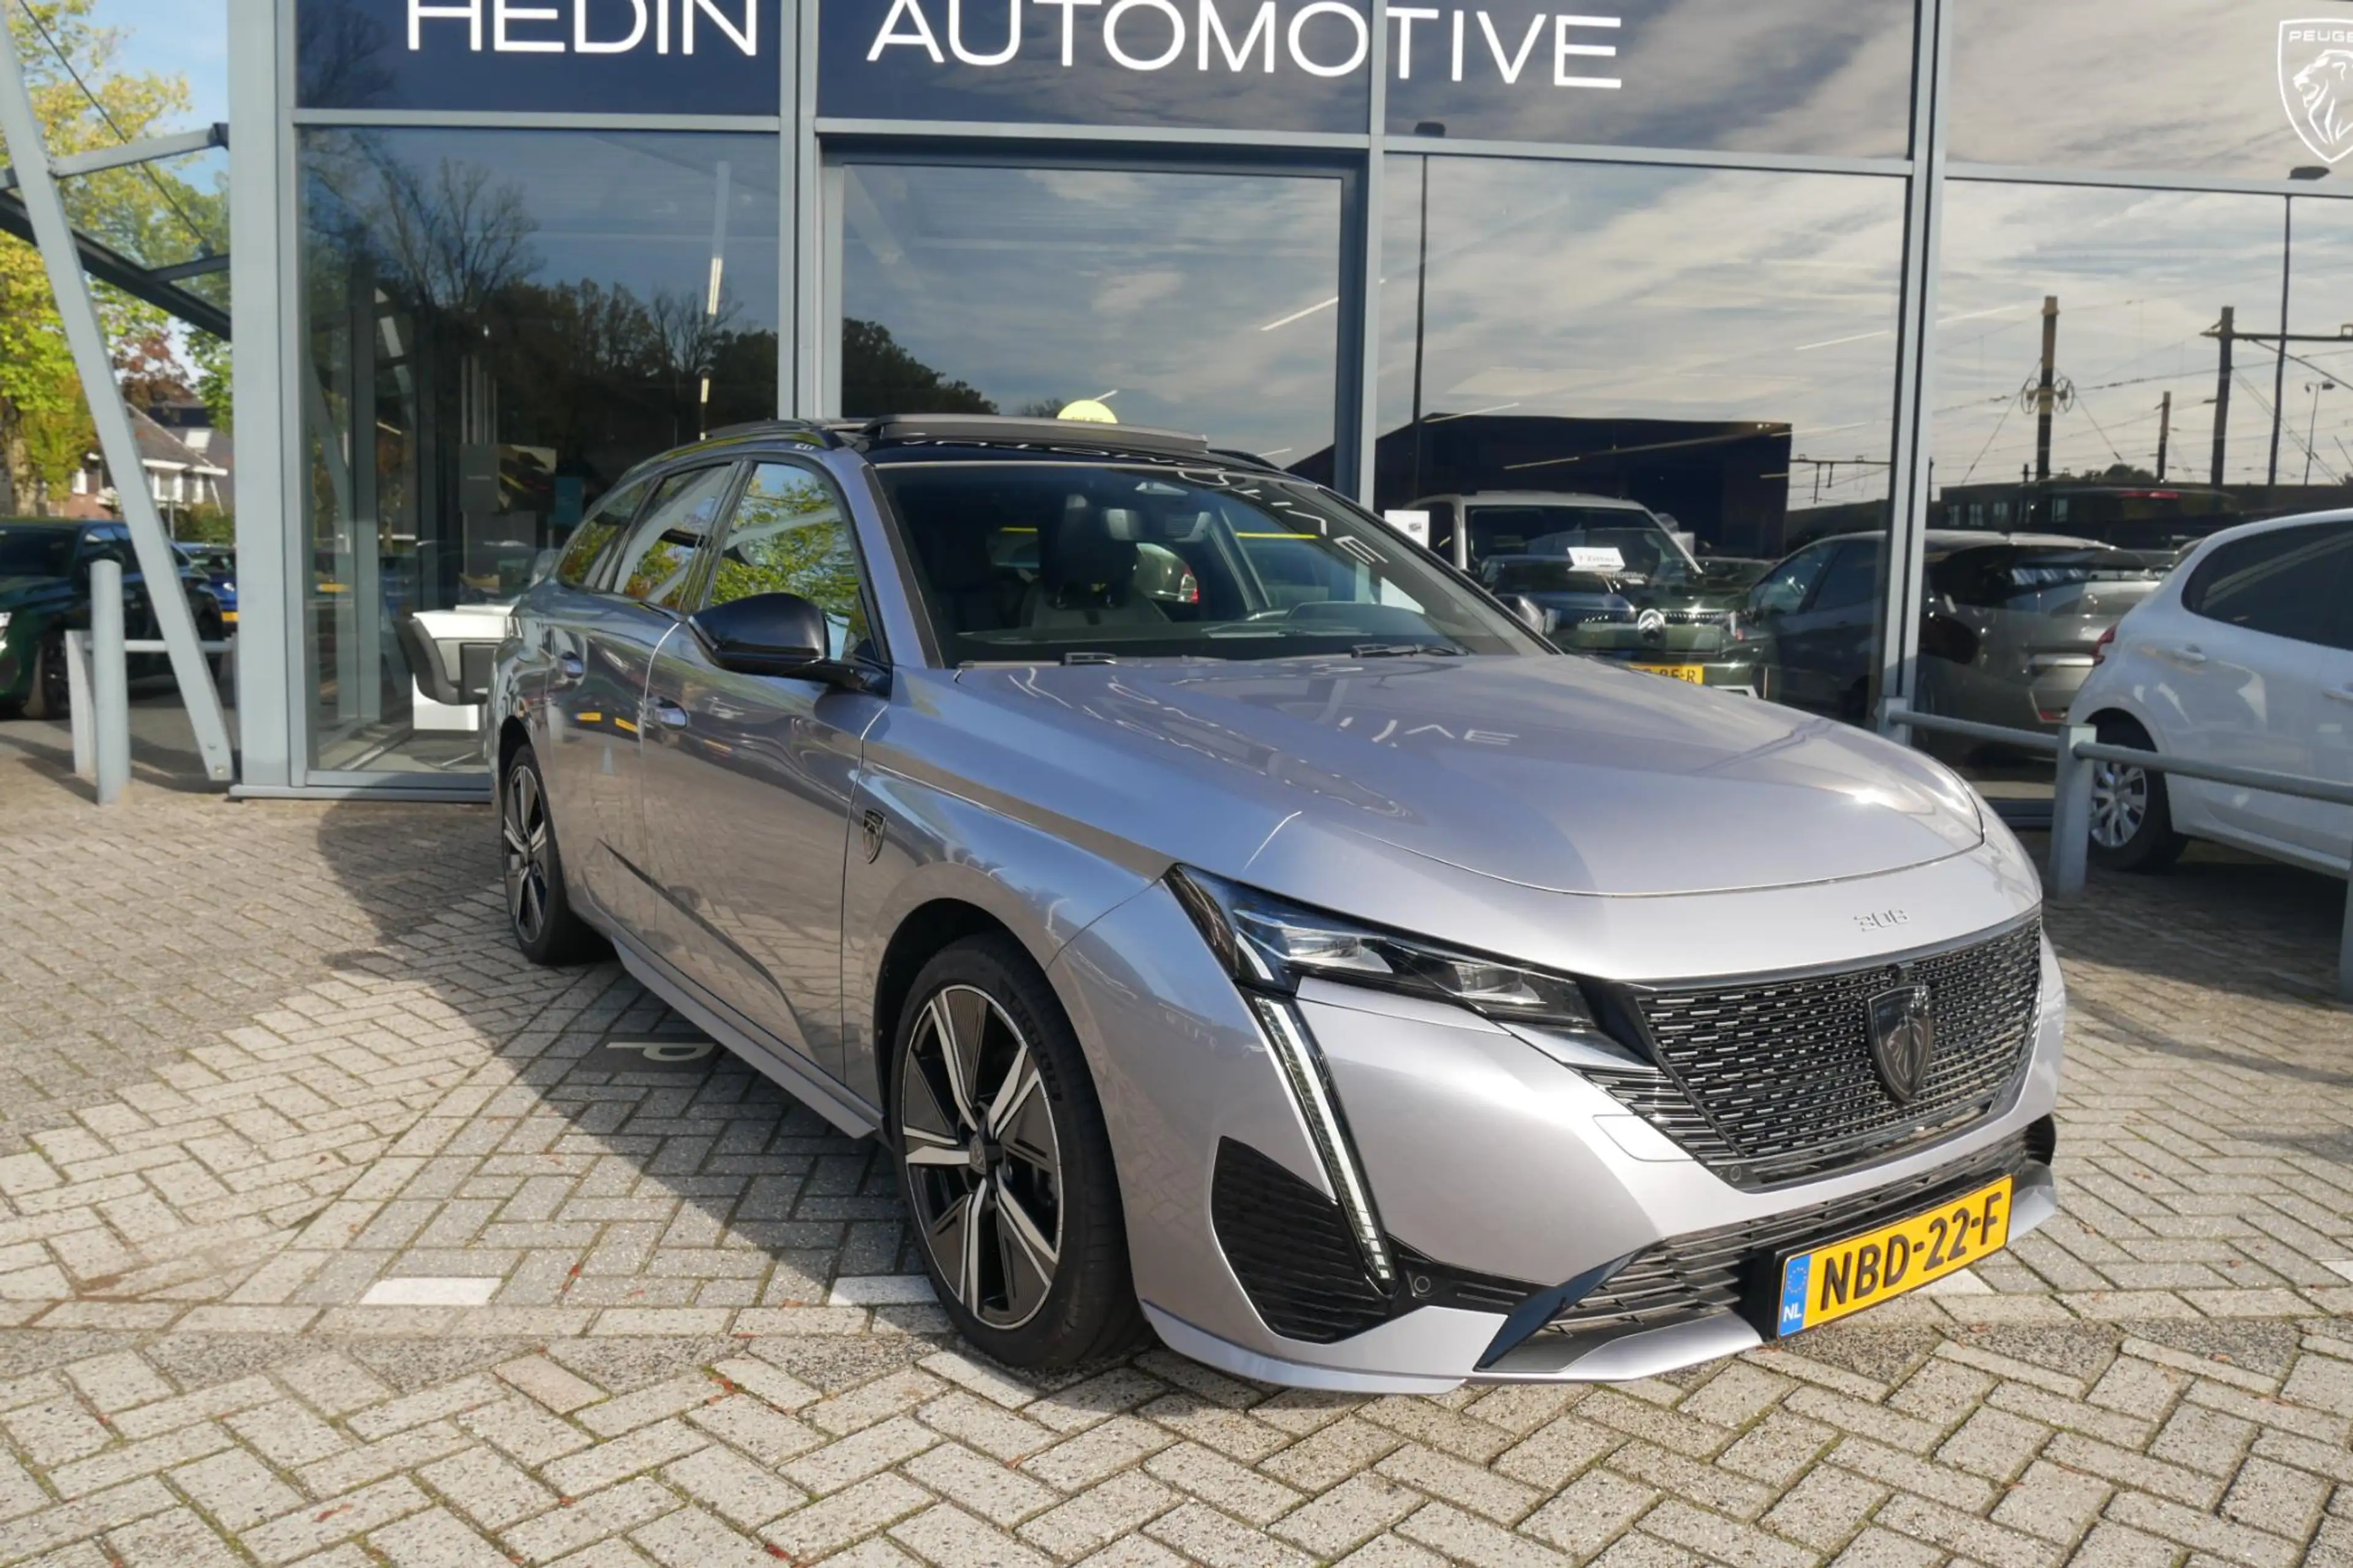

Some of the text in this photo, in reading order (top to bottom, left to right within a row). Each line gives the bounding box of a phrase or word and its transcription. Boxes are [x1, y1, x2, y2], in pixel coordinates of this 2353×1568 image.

[407, 0, 1622, 89] HEDIN AUTOMOTIVE
[1821, 1192, 2002, 1311] NBD-22-F
[1783, 1302, 1802, 1323] NL
